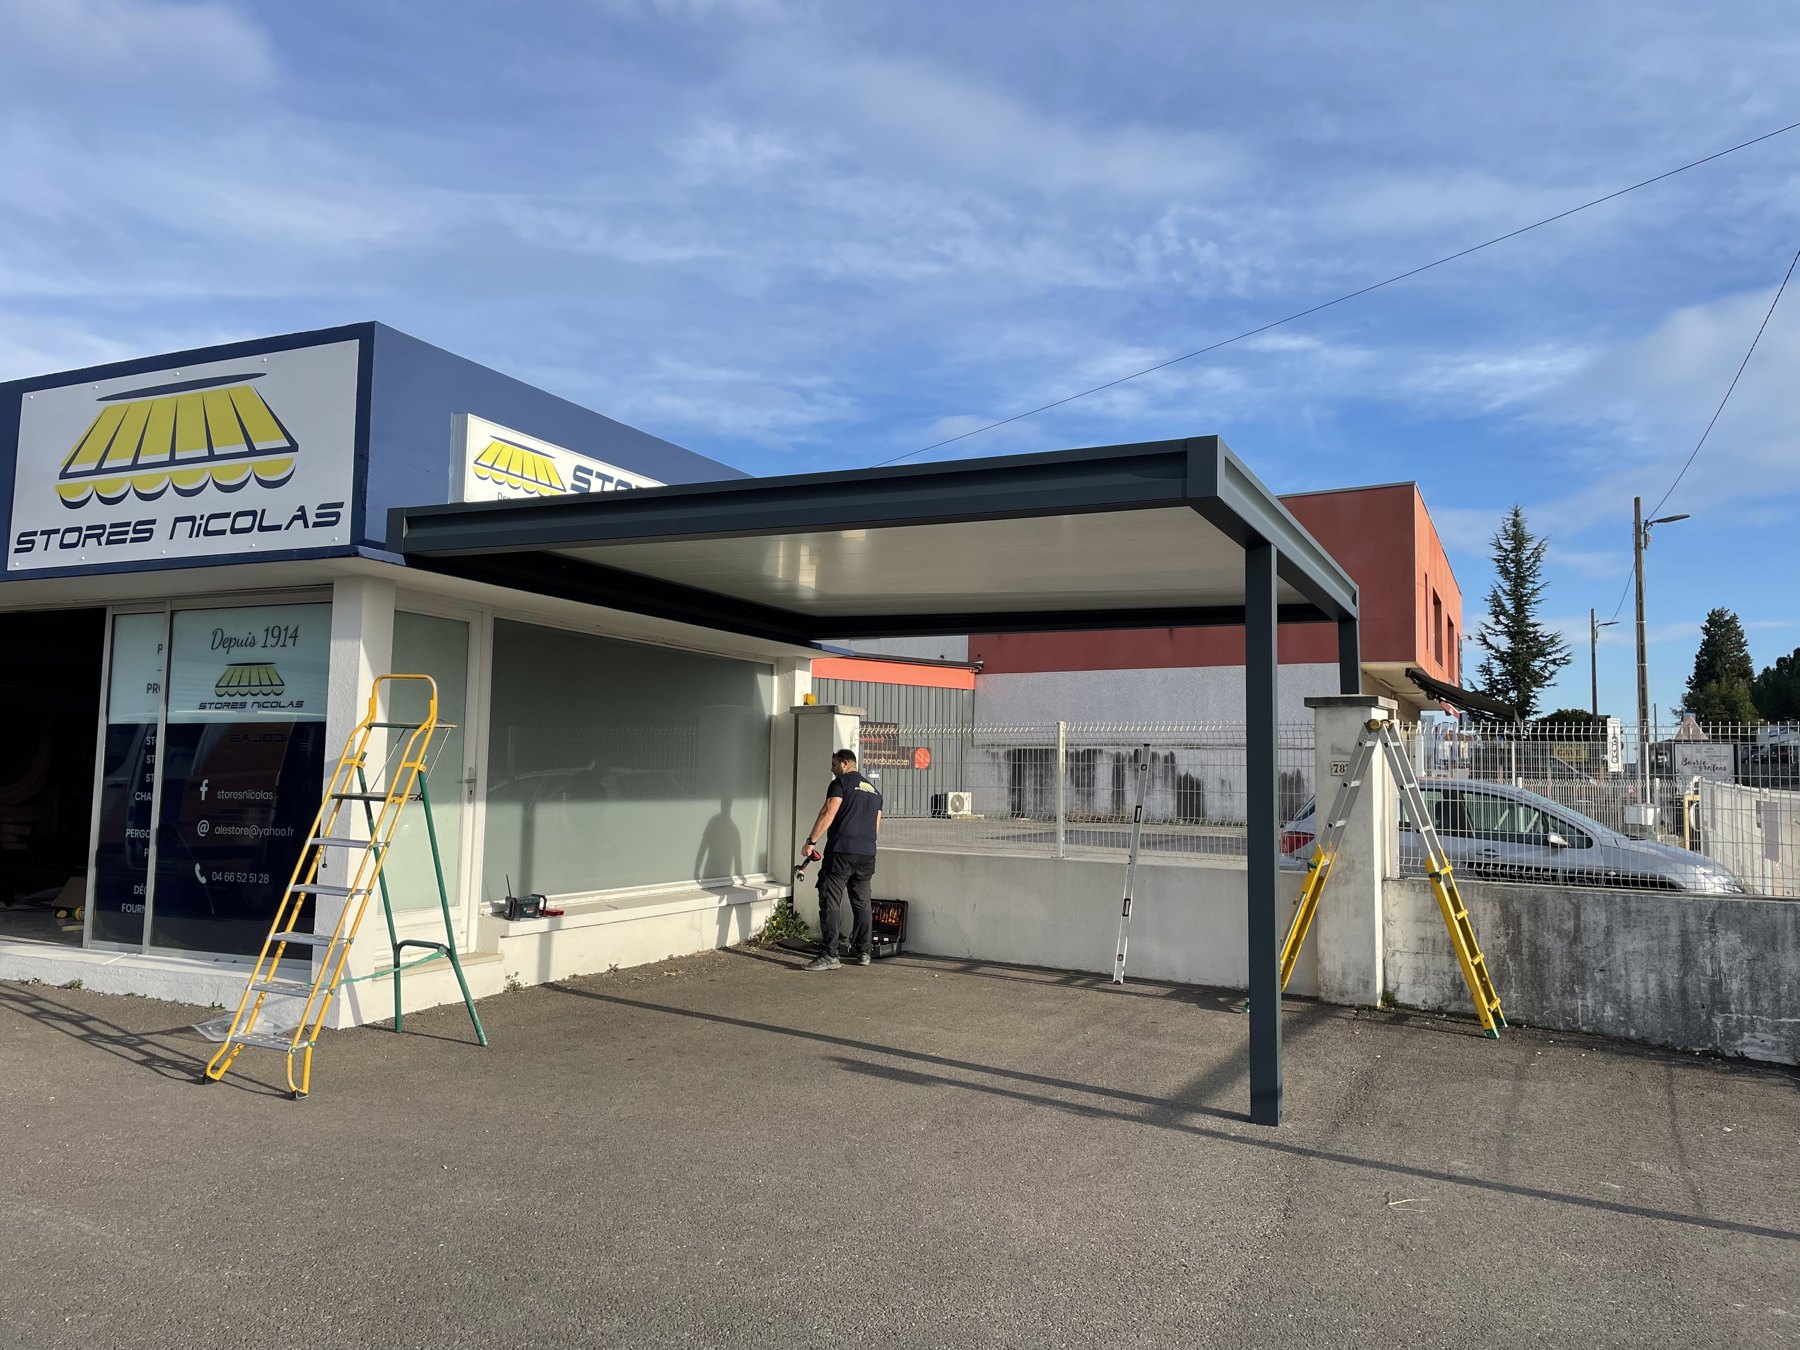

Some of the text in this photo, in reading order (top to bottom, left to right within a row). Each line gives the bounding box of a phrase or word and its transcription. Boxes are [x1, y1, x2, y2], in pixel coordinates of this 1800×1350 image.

[13, 518, 158, 554] STORES
[210, 624, 300, 655] Depuis 1914
[198, 701, 248, 710] STORES
[1333, 763, 1348, 773] 78
[216, 789, 274, 801] storesnicolas
[214, 824, 295, 839] alestore@yahoo.fr
[211, 871, 270, 884] 04 66 52 51 28
